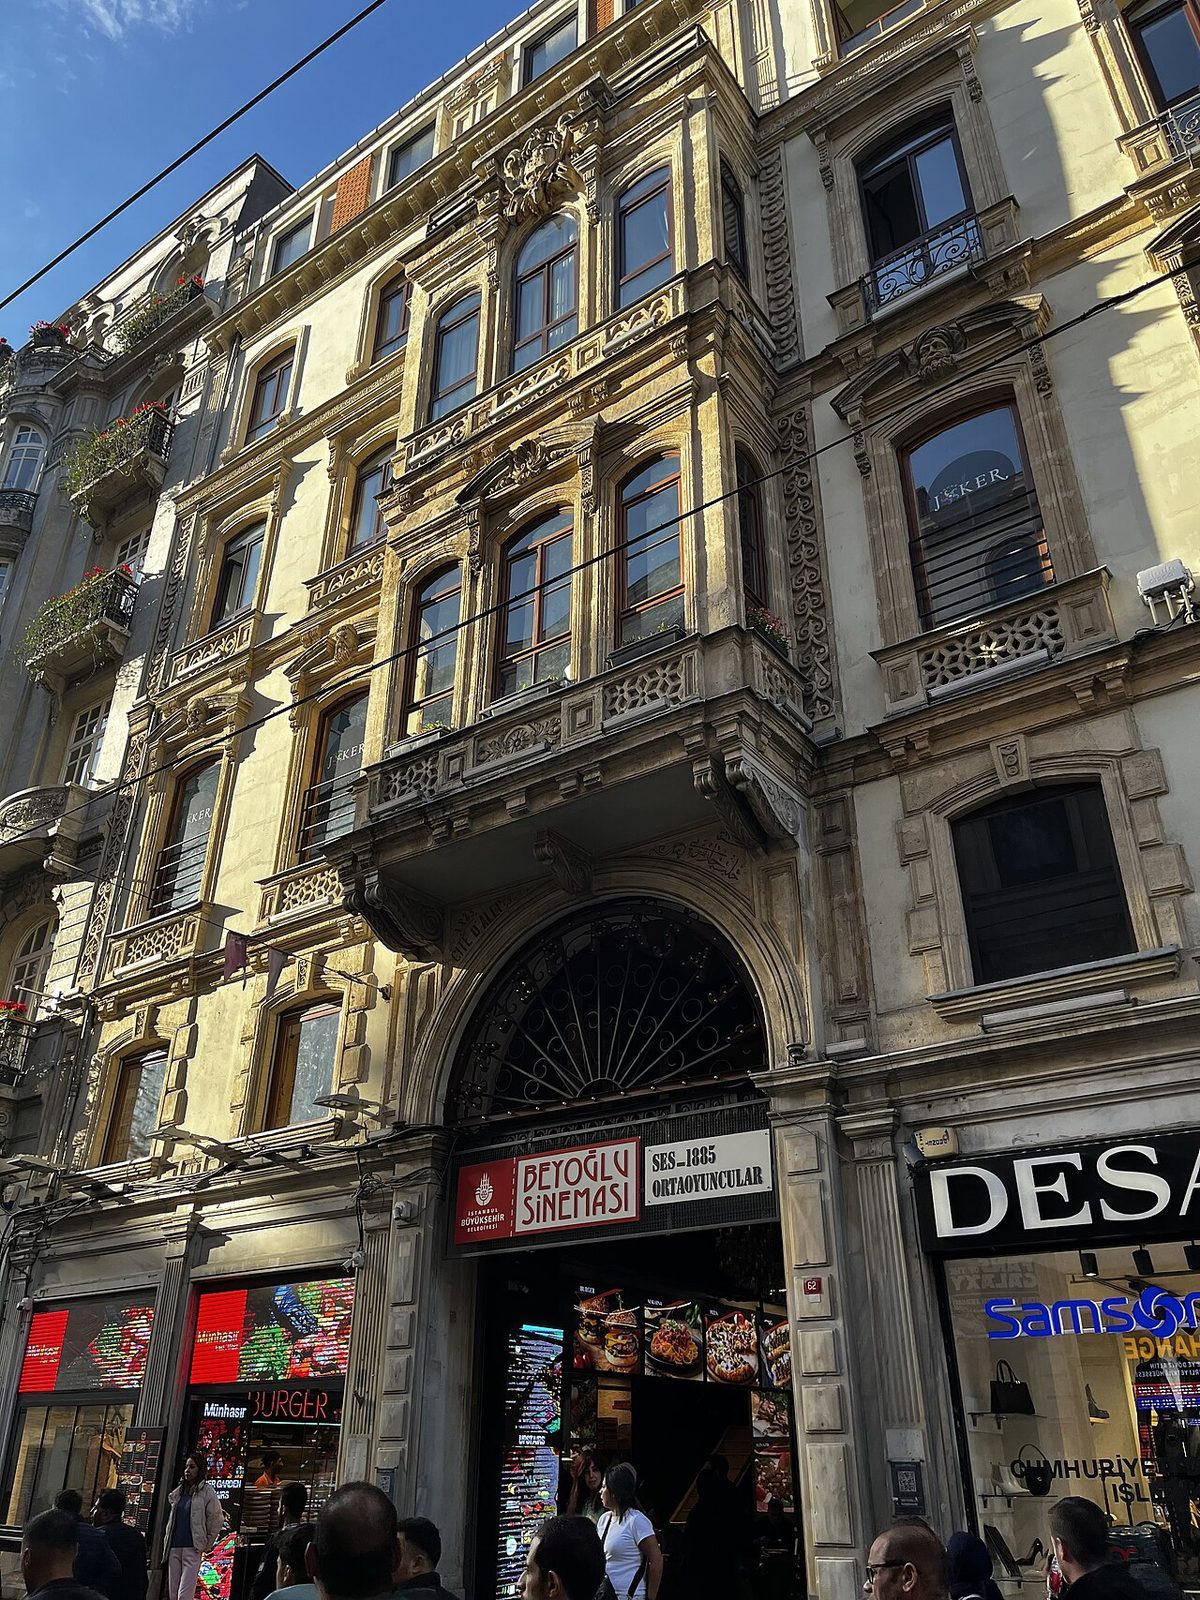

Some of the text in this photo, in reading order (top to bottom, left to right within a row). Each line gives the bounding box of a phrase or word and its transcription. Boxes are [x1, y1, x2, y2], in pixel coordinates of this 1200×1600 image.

[523, 1149, 629, 1193] BEYOĞLU
[652, 1166, 763, 1198] ORTAOYUNCULAR
[929, 1144, 1200, 1238] DES
[807, 1280, 817, 1291] 62
[203, 1402, 247, 1419] Münhasır
[247, 1389, 329, 1419] BURGER
[216, 1479, 242, 1489] GARDEN
